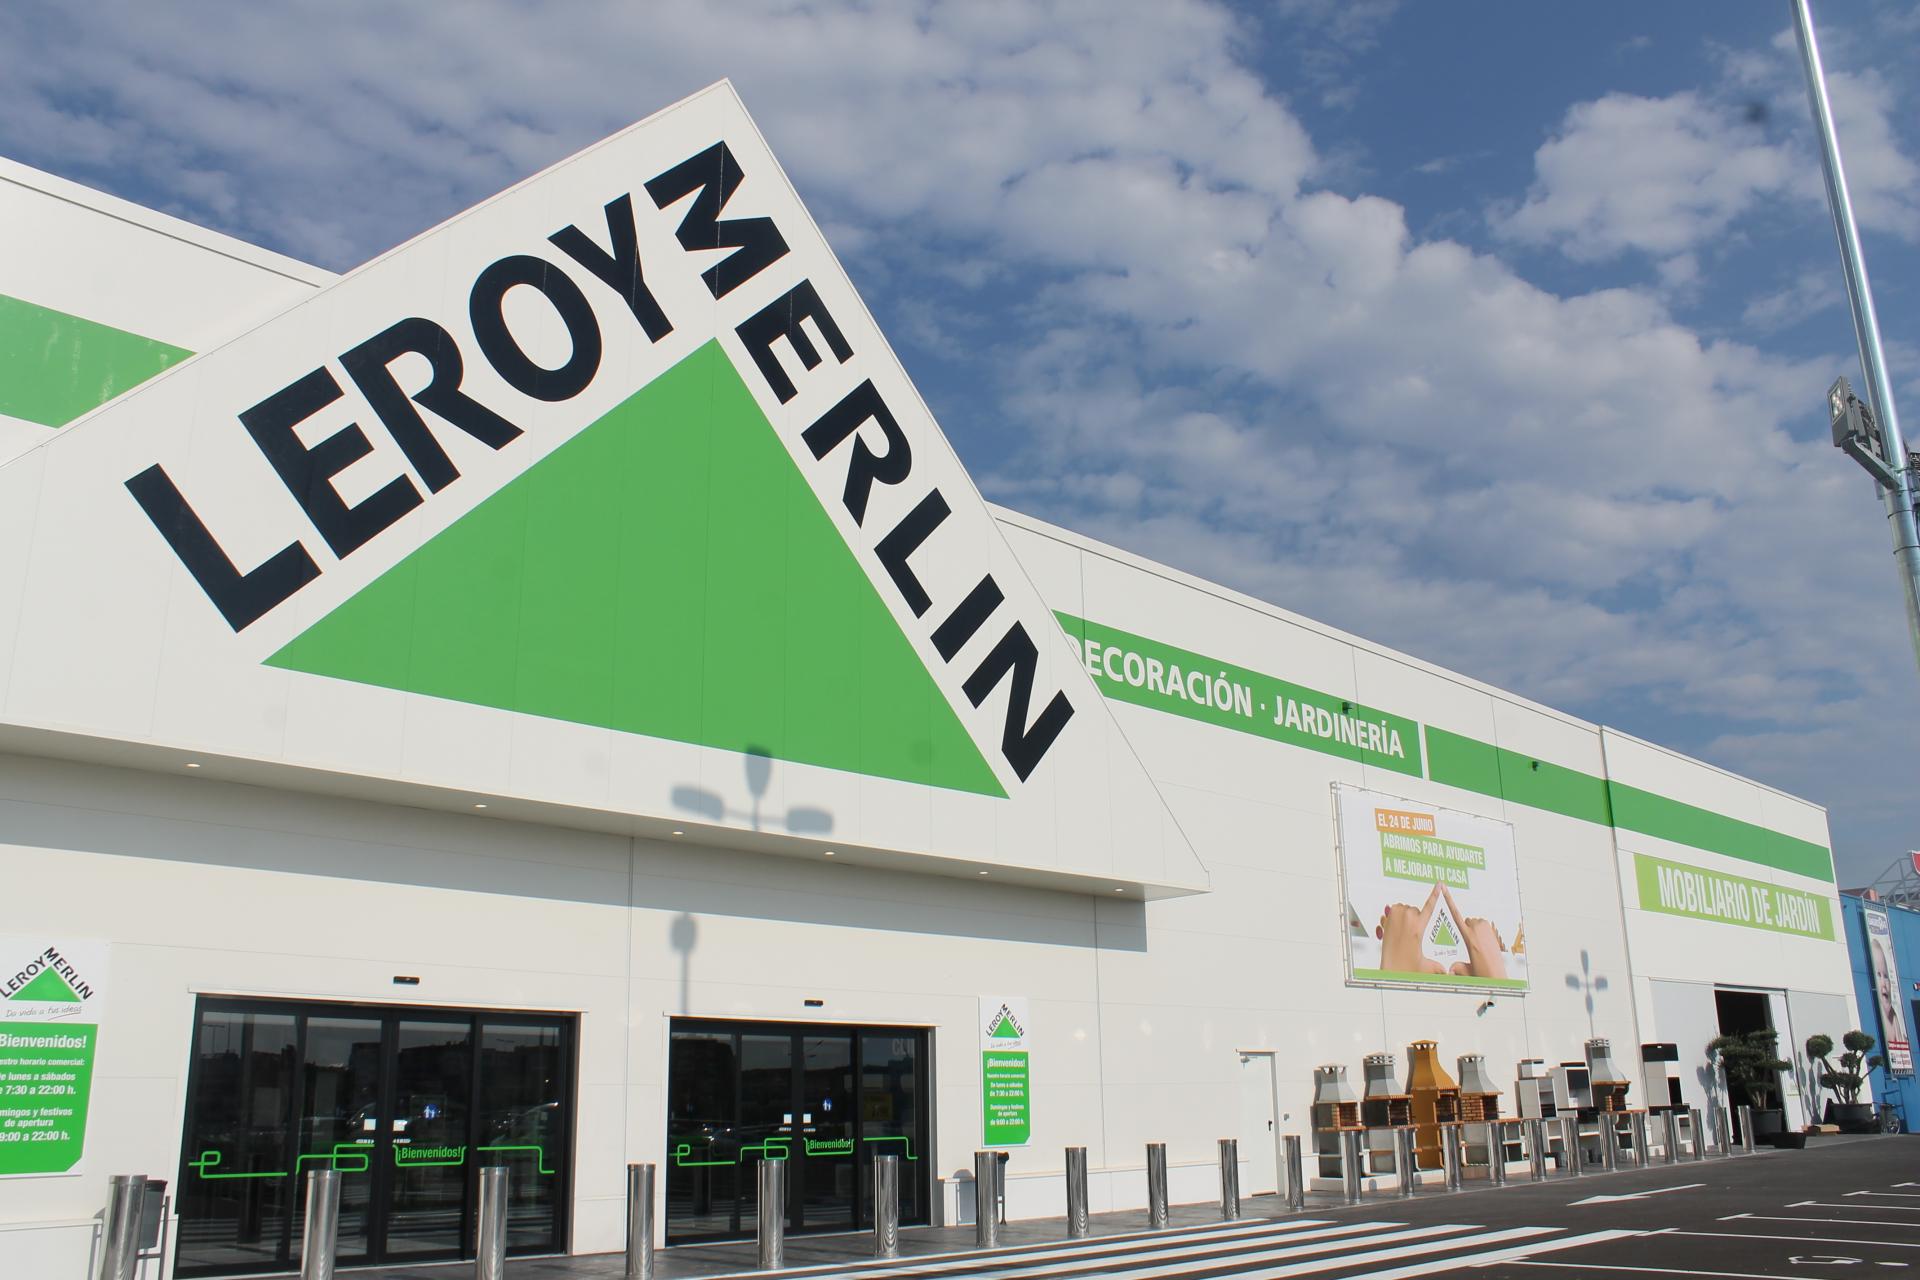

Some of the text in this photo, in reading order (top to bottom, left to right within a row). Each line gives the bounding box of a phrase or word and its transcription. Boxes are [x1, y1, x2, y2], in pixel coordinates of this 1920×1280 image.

[124, 192, 673, 633] LEROY
[643, 140, 1075, 784] MERLIN
[1274, 695, 1405, 758] JARDINERÍA
[1378, 813, 1433, 832] EL 24 DE JUNIO
[1383, 833, 1484, 865] ABRIMOS PARA AYUDARTE
[1385, 857, 1468, 884] A MEJORAR TU CASA
[1657, 865, 1750, 921] MOBILIARIO
[1752, 886, 1773, 925] DE
[1775, 892, 1821, 933] JARDÍN
[0, 955, 46, 998] LEROY
[43, 946, 94, 1000] MERLIN
[986, 1009, 1004, 1036] LEROY
[1001, 1003, 1024, 1037] MERLIN
[20, 1058, 46, 1066] horario
[8, 1072, 32, 1080] lunes
[41, 1072, 76, 1080] sábados
[6, 1085, 28, 1095] 7:30
[30, 1087, 36, 1095] a
[38, 1085, 66, 1095] 22:00
[67, 1085, 76, 1095] h.
[5, 1118, 54, 1128] de apertura
[33, 1109, 38, 1118] y
[40, 1107, 72, 1116] festivos
[32, 1131, 59, 1141] 22:00
[61, 1131, 70, 1140] h.
[398, 1146, 461, 1161] ¡Bienvenidos!
